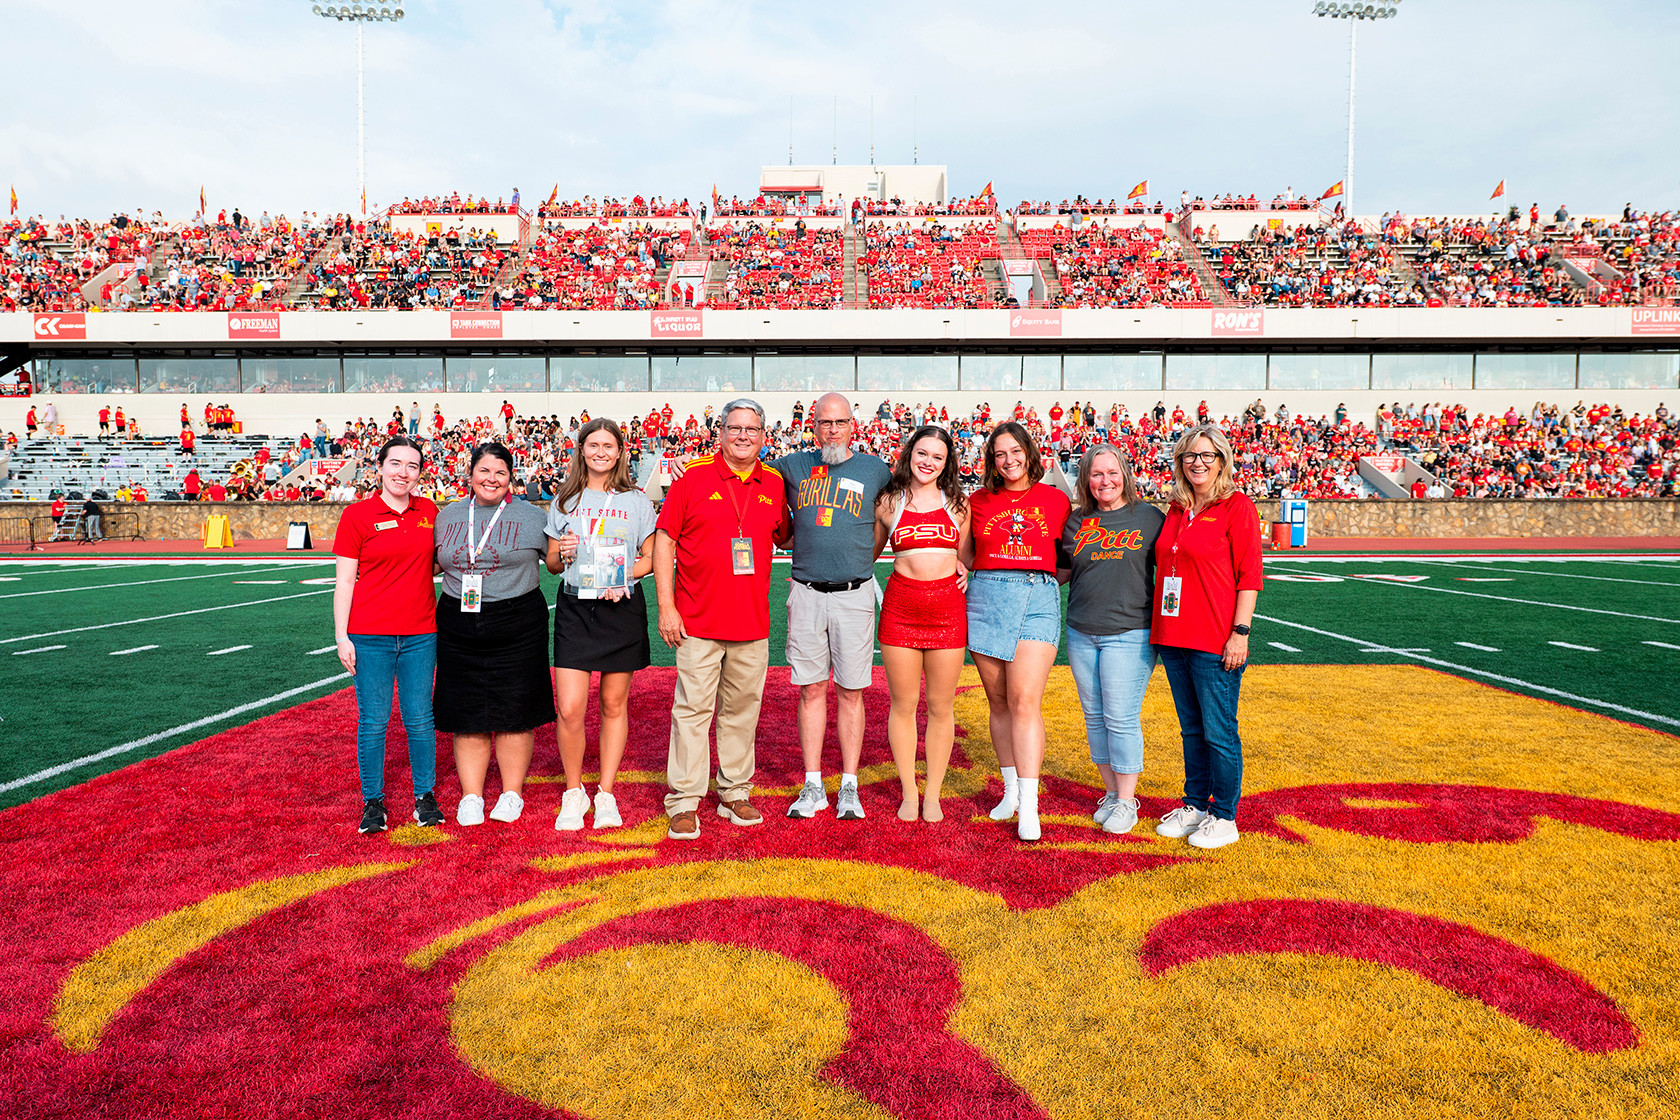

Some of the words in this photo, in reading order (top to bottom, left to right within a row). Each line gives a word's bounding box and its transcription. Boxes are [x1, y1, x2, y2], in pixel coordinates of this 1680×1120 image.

[1214, 312, 1262, 329] RON'S
[1633, 310, 1680, 322] UPLINK
[35, 317, 61, 335] CK
[241, 318, 278, 329] FREEMAN
[657, 322, 702, 332] LIQUOR
[757, 494, 773, 505] Pitt
[797, 475, 863, 518] GORILLAS
[598, 508, 628, 520] STATE
[894, 524, 957, 545] PSU
[1073, 526, 1144, 556] Pitt
[1000, 544, 1032, 556] ALUMNI
[1091, 551, 1124, 560] DANCE
